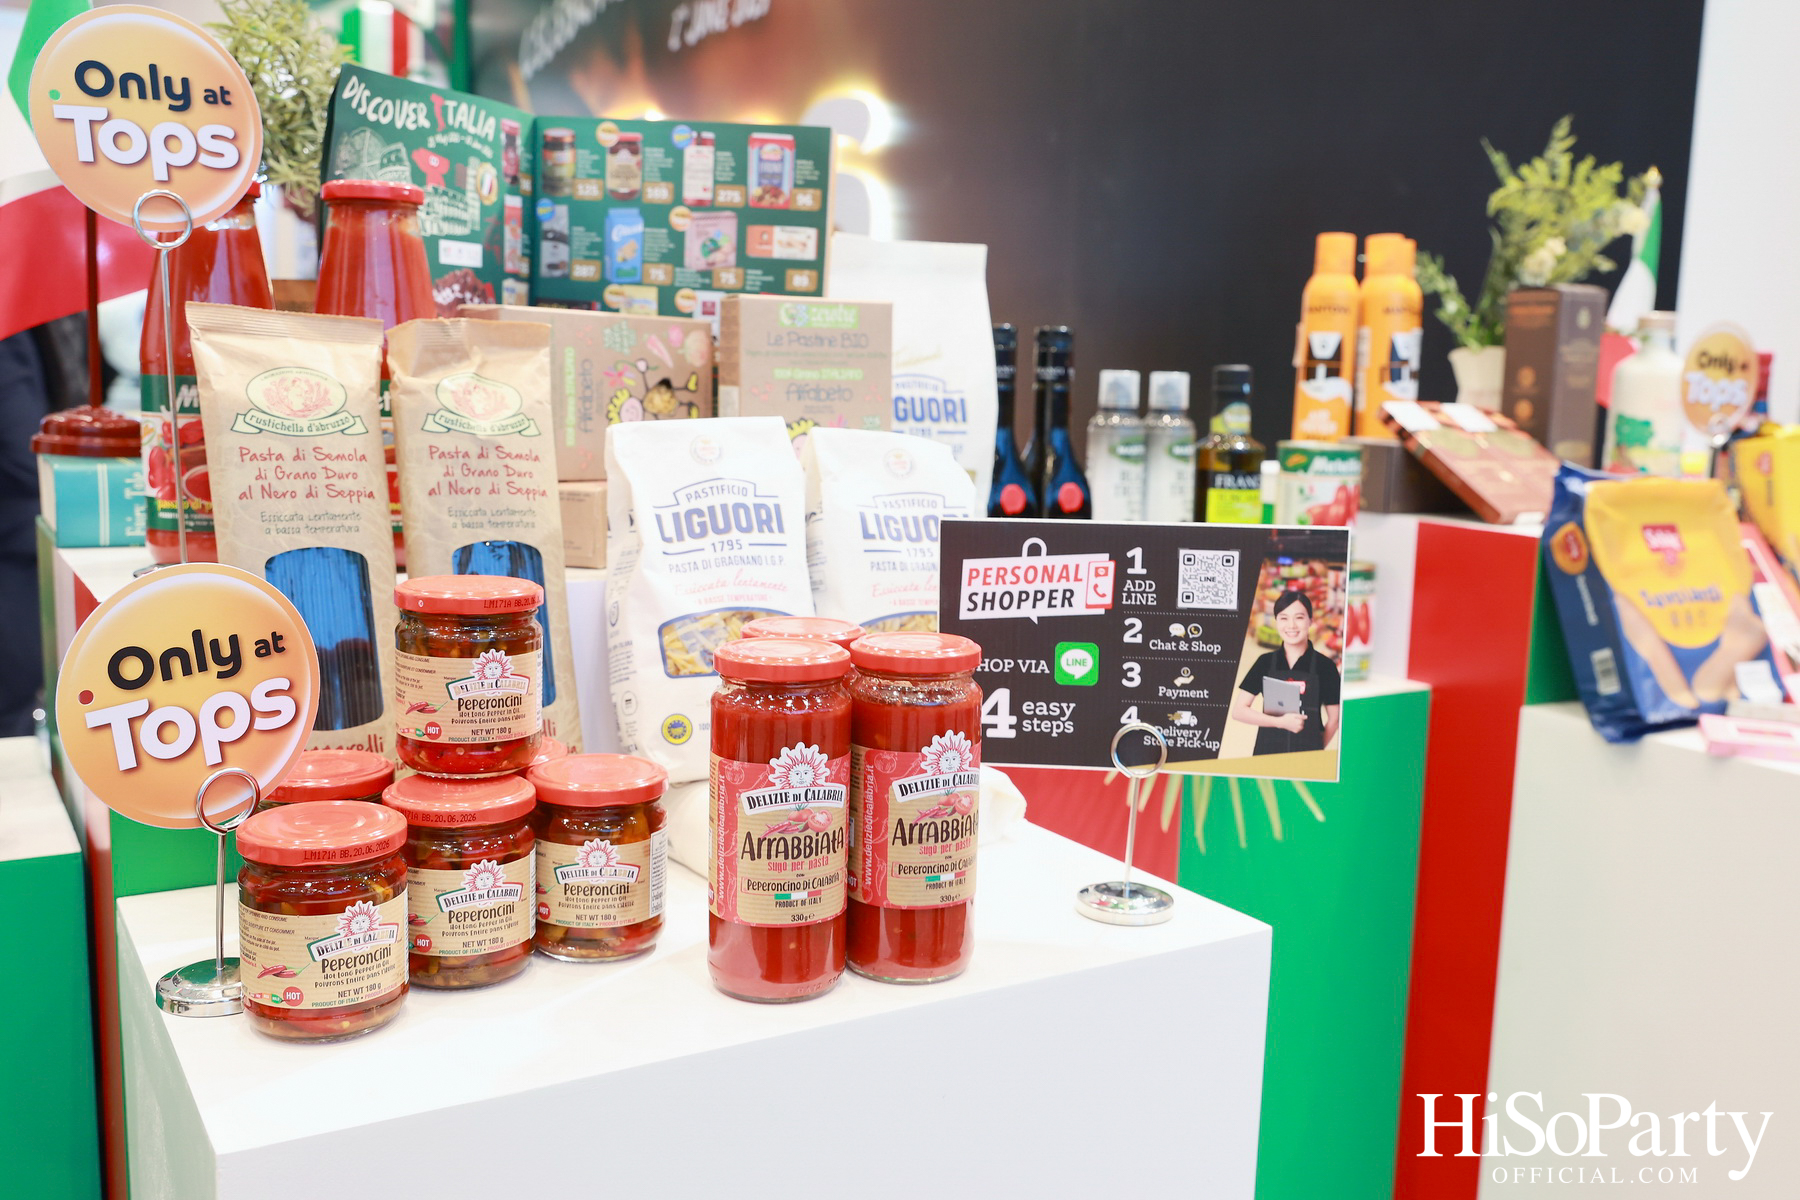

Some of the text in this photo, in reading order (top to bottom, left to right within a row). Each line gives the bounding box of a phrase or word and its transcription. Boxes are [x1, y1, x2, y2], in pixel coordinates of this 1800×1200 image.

[75, 60, 232, 112] Only at
[342, 75, 431, 131] DISCOVER
[53, 104, 240, 182] Tops
[767, 332, 783, 346] Le
[1697, 351, 1733, 374] Only
[785, 383, 854, 401] Alfabeto
[1686, 371, 1748, 412] Tops
[892, 396, 967, 423] GUORI
[249, 414, 350, 433] rustichella d'abruzzo
[239, 446, 368, 463] Pasta di Semola
[428, 445, 541, 462] Pasta di Semola
[255, 465, 358, 481] di Grano Duro
[443, 463, 534, 479] di Grano Duro
[238, 482, 375, 504] al Nero di Seppia
[428, 481, 441, 496] al
[448, 480, 481, 496] Nero
[488, 482, 500, 495] di
[506, 481, 547, 501] Seppia
[685, 483, 748, 503] PASTIFICIO
[655, 501, 785, 544] LIGUORI
[859, 512, 968, 543] LIGUO
[711, 538, 744, 554] 1795
[669, 560, 699, 574] PASTA
[702, 558, 712, 570] DI
[714, 555, 764, 569] GRAGNANO
[1126, 546, 1148, 575] 1
[967, 563, 1083, 587] PERSONAL
[1199, 575, 1217, 584] LINE
[1123, 579, 1157, 592] ADD
[966, 588, 1075, 612] SHOPPER
[1122, 592, 1157, 606] LINE
[1122, 617, 1144, 644] 2
[1149, 639, 1222, 654] Chat & Shop
[107, 629, 287, 691] Only at
[975, 658, 1050, 674] HOP VIA
[1066, 657, 1088, 668] LINE
[1121, 661, 1142, 688] 3
[1158, 686, 1209, 699] Payment
[457, 694, 522, 712] Peperoncini
[1022, 700, 1076, 721] easy
[981, 687, 1018, 739] 4
[1120, 705, 1141, 729] 4
[85, 677, 296, 771] Tops
[427, 726, 439, 736] HOT
[1022, 716, 1075, 737] steps
[1155, 725, 1202, 740] Delivery
[1176, 737, 1220, 752] Pick-up
[898, 777, 941, 797] DELIZIE
[746, 791, 791, 810] DELIZIE
[804, 788, 844, 803] CALABRIA
[401, 811, 476, 824] 171A BB.20.06.2026
[303, 840, 390, 862] LM171A BB.20.06.2026
[919, 844, 937, 856] sugo
[941, 843, 952, 855] per
[767, 855, 829, 873] sugo per pasta
[898, 862, 949, 876] Peperoncino
[560, 868, 590, 880] DELIZIE
[564, 882, 629, 896] Peperoncini
[747, 878, 801, 892] Peperoncino
[443, 893, 476, 908] DELIZIE
[487, 888, 519, 899] CALABRIA
[775, 897, 822, 908] PRODUCT ITALY
[448, 902, 515, 923] Peperoncini
[316, 940, 352, 957] DELIZIE
[321, 944, 392, 973] Peperoncini
[286, 991, 301, 1000] HOT
[337, 984, 377, 998] NET WT 180
